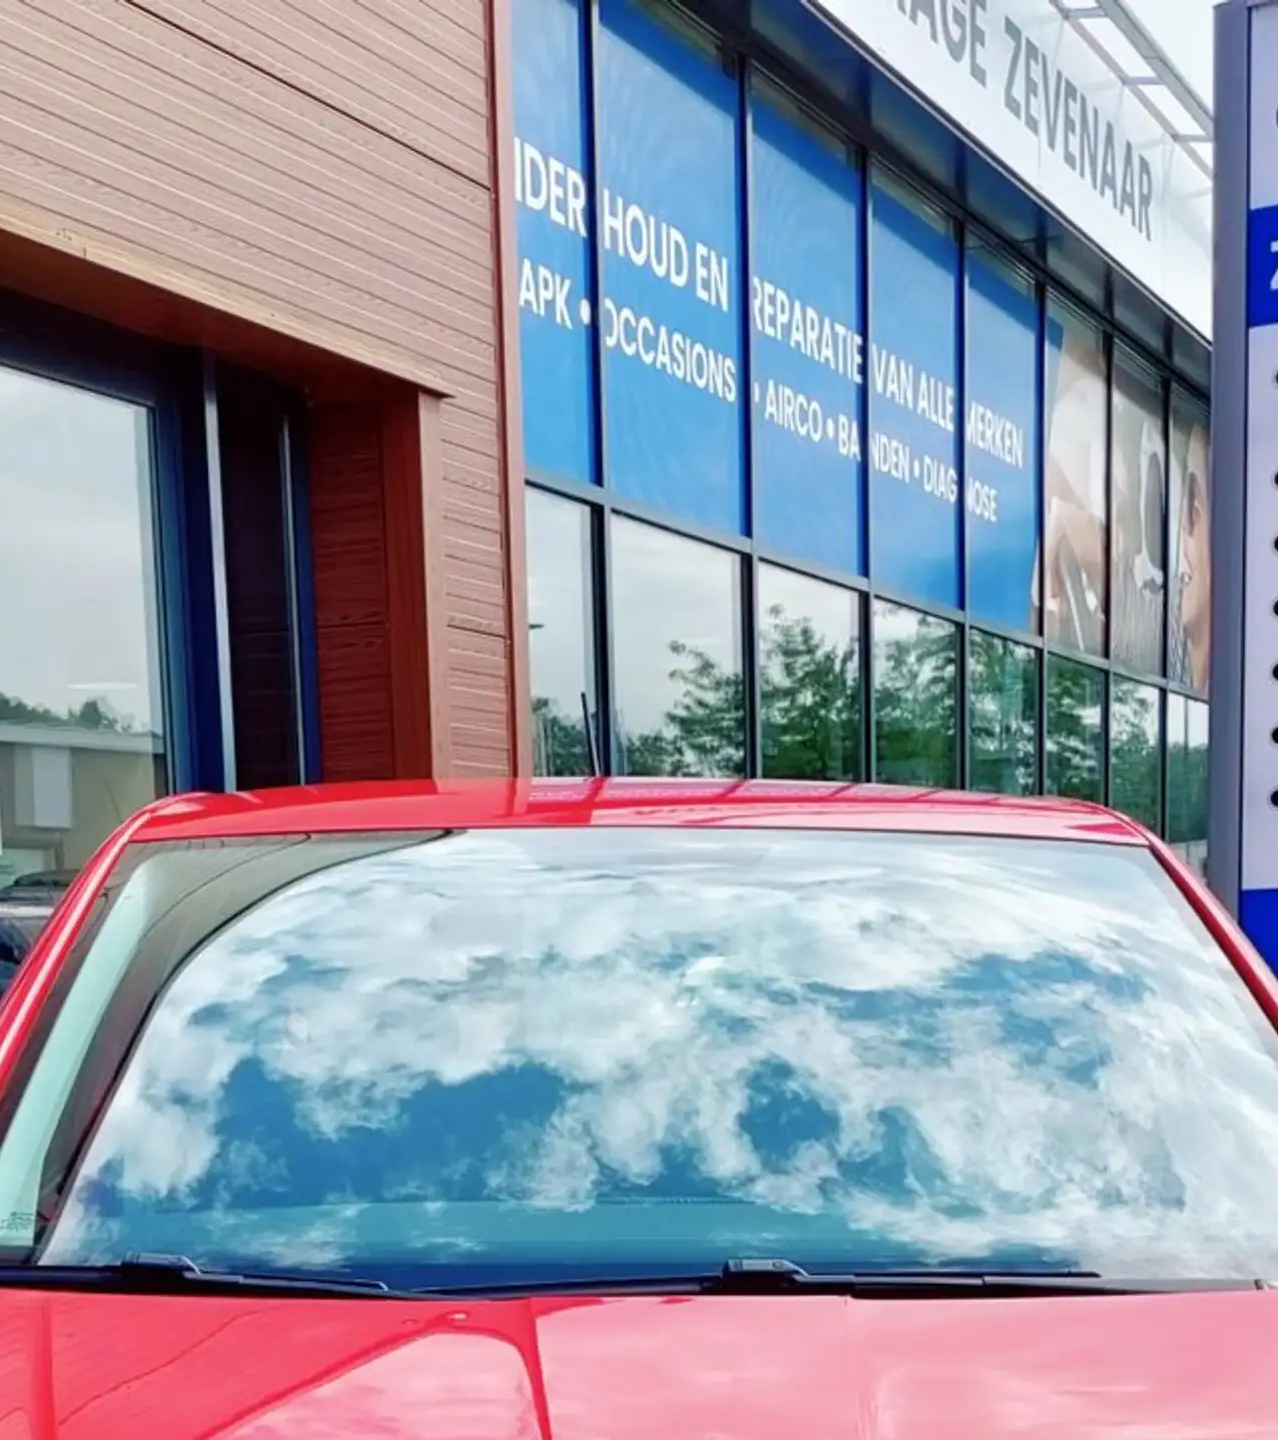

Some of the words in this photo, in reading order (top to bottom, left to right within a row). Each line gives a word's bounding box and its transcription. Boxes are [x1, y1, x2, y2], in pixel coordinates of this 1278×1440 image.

[1004, 16, 1153, 242] ZEVENAAR
[519, 258, 573, 330] APK
[765, 379, 822, 443] AIRCO
[695, 241, 729, 312] EN
[870, 342, 913, 410] VAN
[917, 371, 955, 433] ALLE
